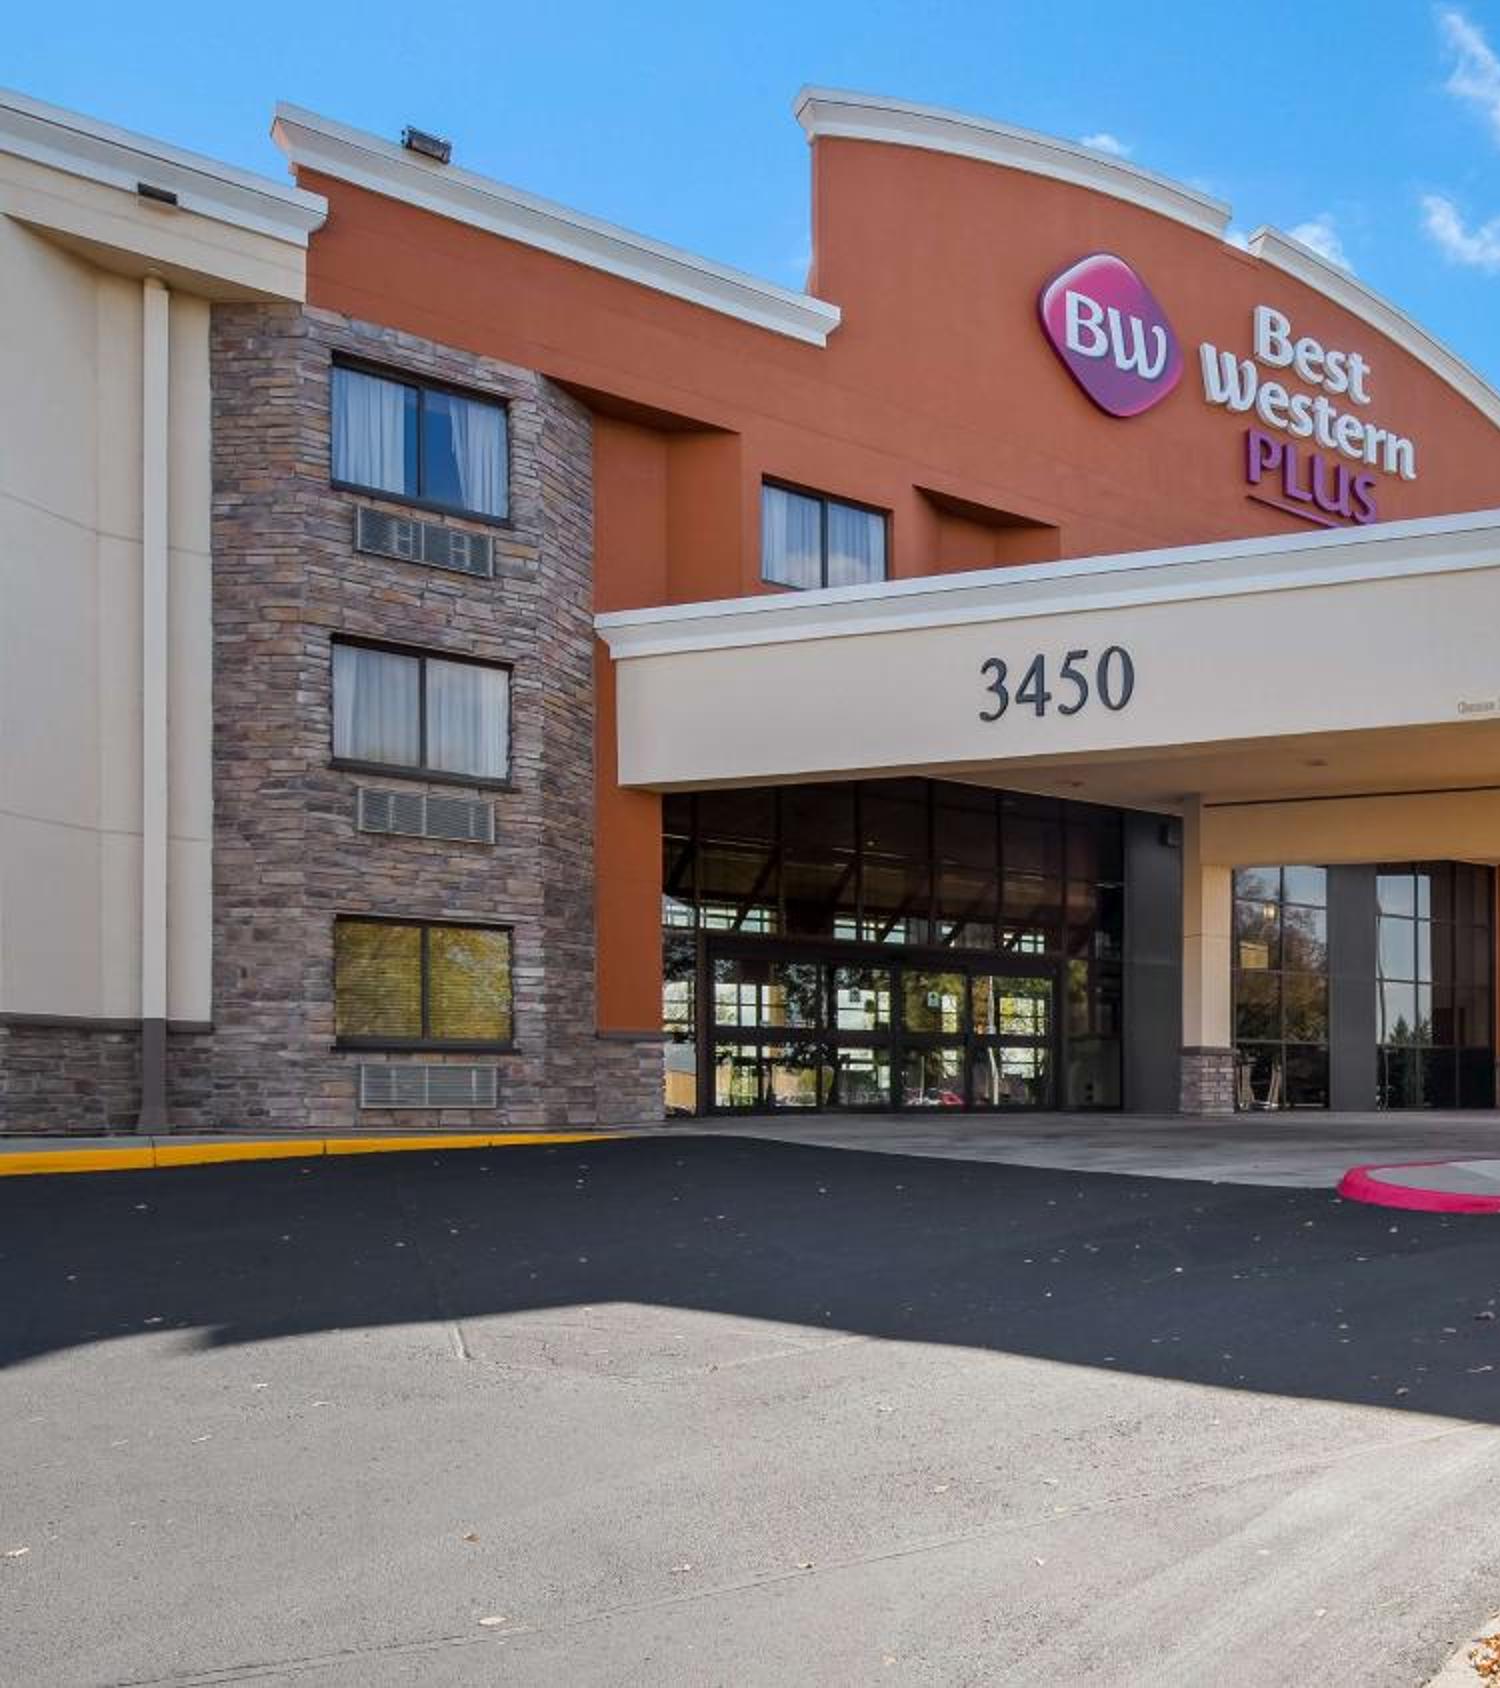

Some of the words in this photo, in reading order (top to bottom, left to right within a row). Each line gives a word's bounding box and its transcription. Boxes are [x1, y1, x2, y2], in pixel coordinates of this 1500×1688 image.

[1065, 290, 1167, 380] BW
[1254, 305, 1371, 403] Best
[1200, 342, 1416, 479] Western
[1247, 428, 1377, 524] PLUS
[979, 646, 1135, 722] 3450
